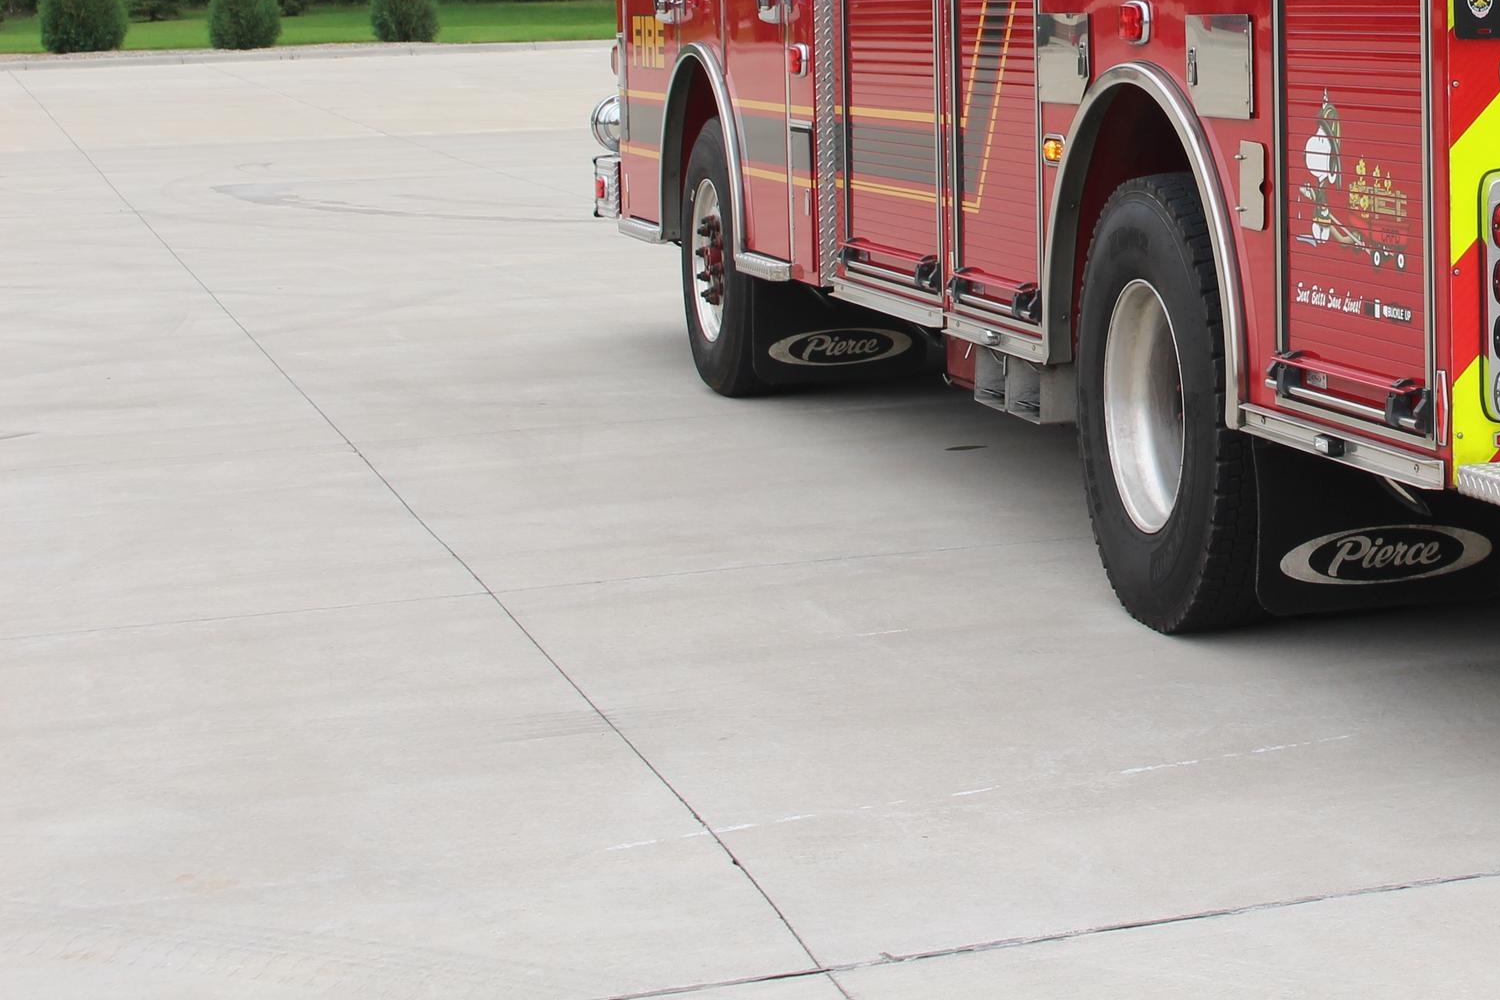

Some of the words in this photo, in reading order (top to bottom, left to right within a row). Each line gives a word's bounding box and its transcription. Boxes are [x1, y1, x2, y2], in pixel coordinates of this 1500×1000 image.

[631, 15, 665, 69] FIRE
[1296, 282, 1310, 303] Seat
[1311, 285, 1327, 306] Belts
[1327, 288, 1342, 309] Save
[1343, 291, 1363, 314] Lives!
[1387, 305, 1404, 320] BUCKLE
[1404, 310, 1411, 321] UP
[801, 334, 880, 361] Pierce
[1328, 535, 1442, 577] Pierce
